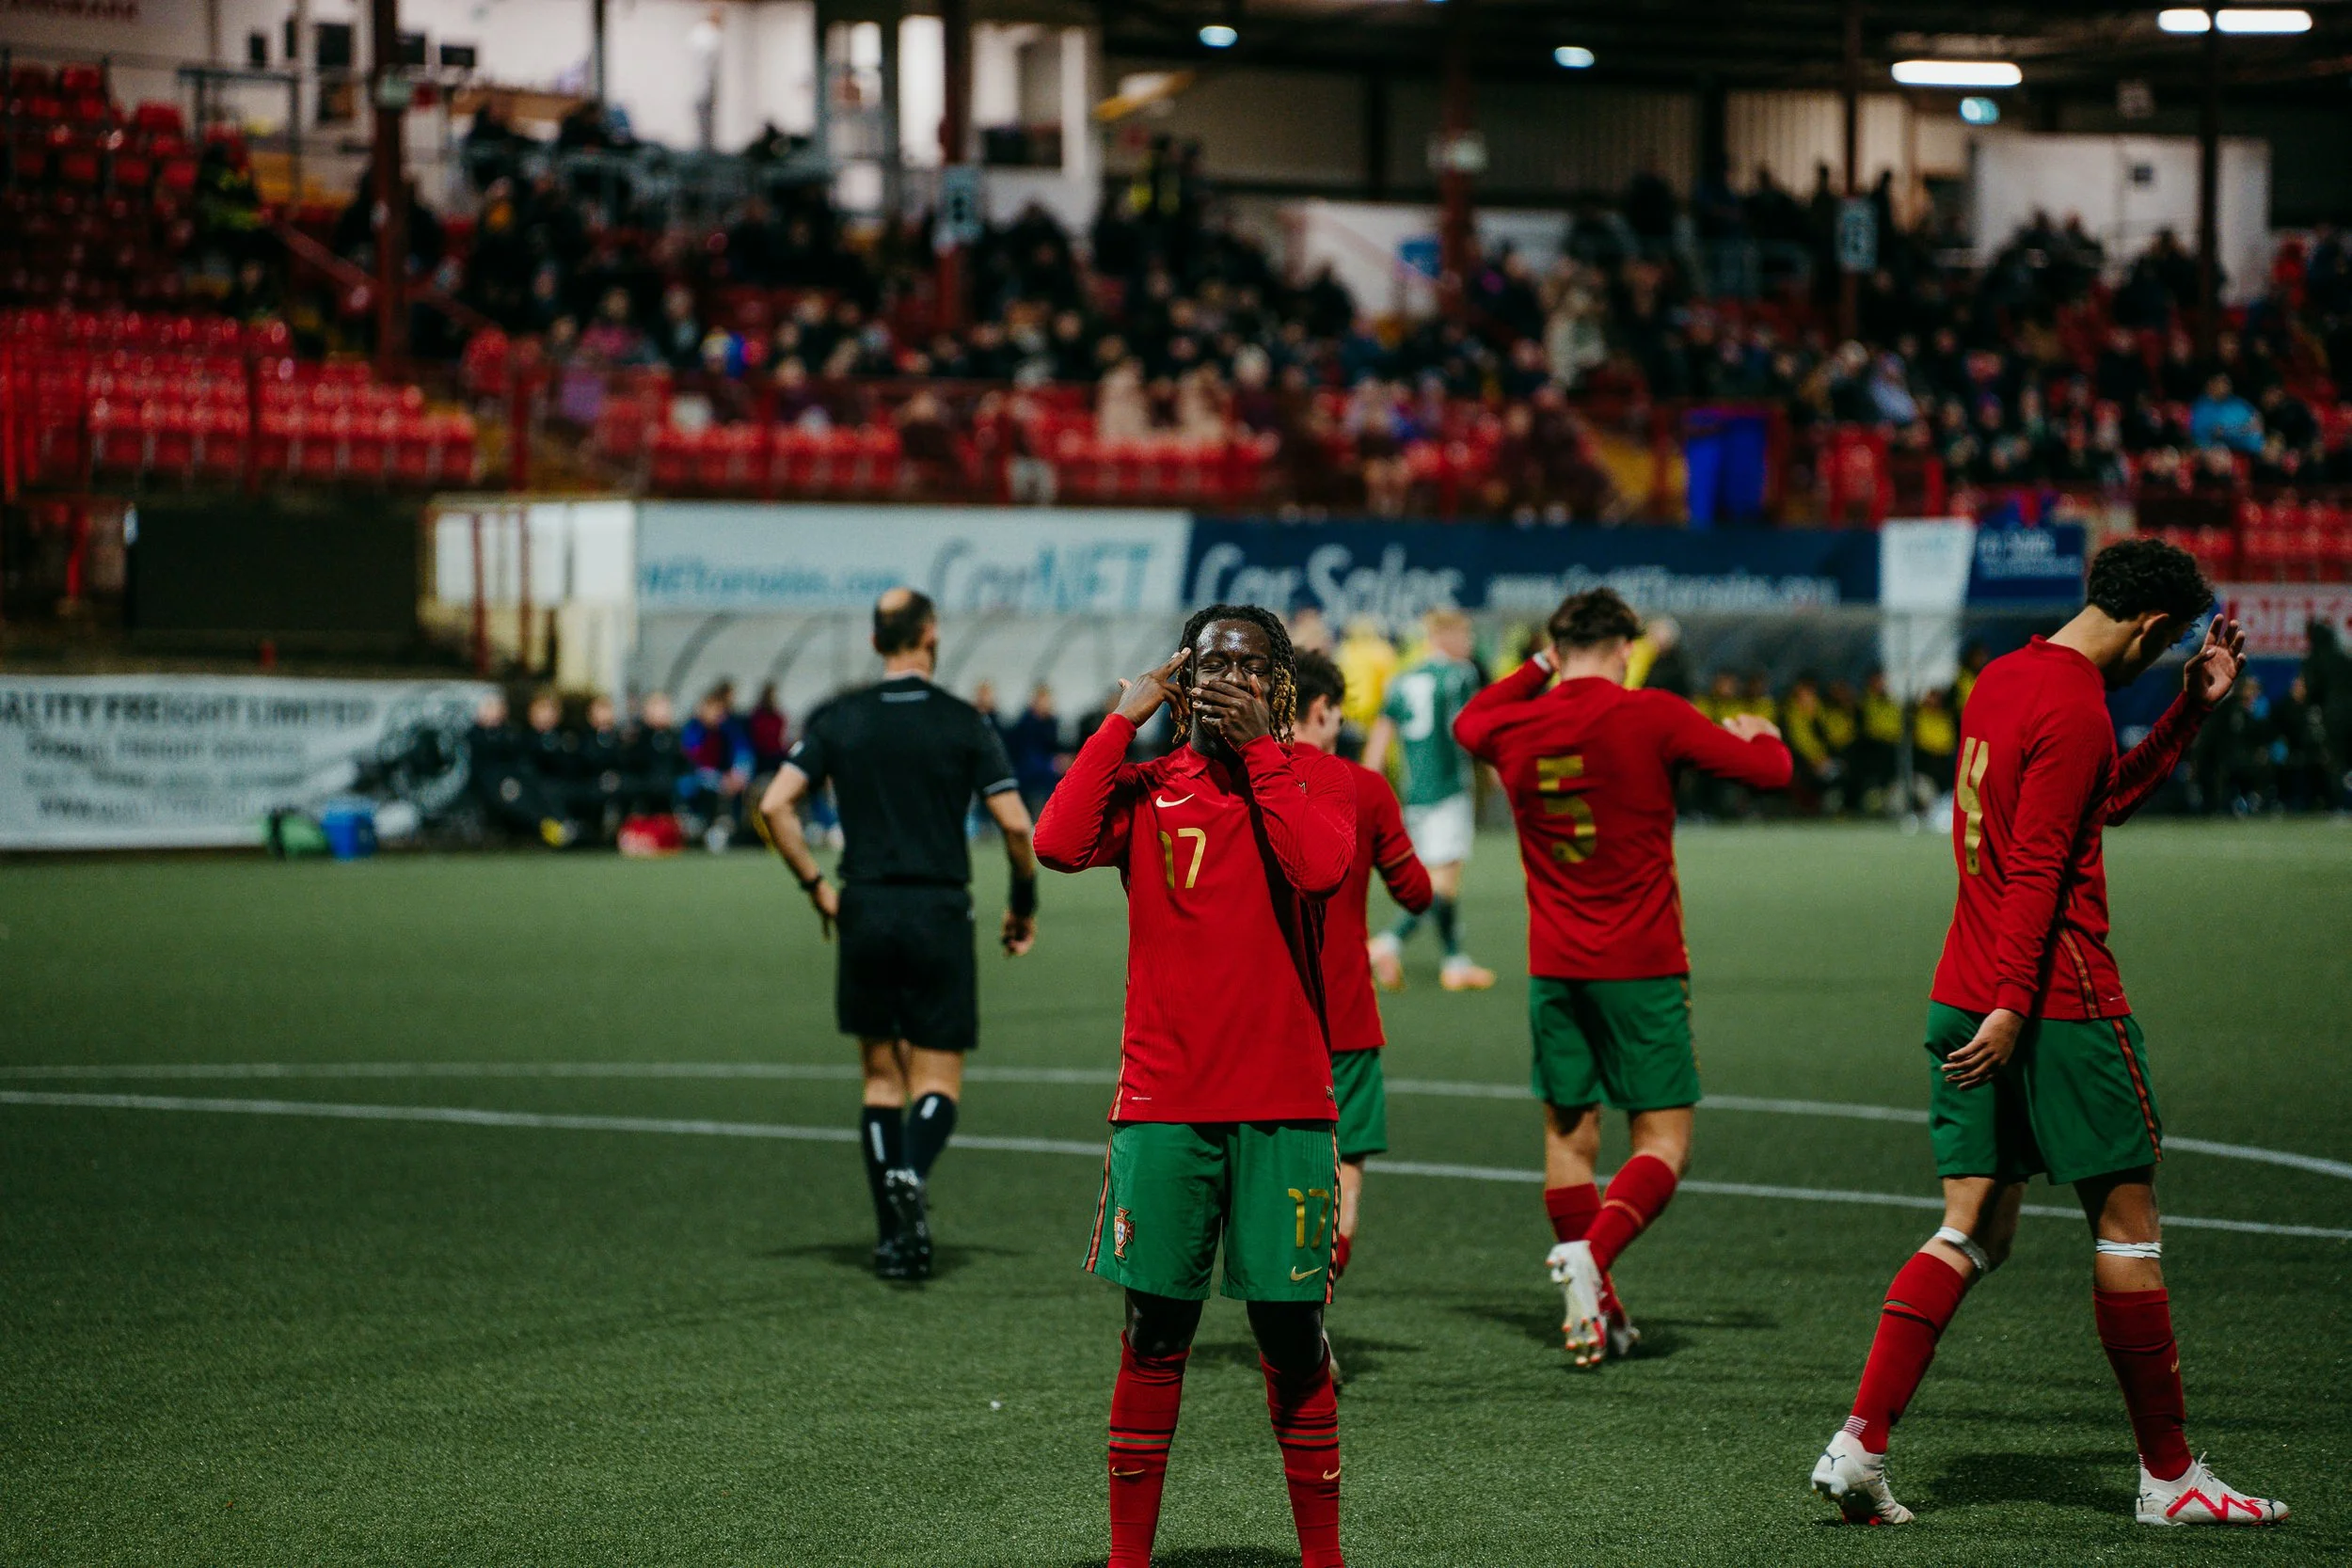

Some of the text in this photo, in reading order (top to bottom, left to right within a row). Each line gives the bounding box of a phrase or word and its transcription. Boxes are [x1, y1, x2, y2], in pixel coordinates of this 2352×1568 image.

[1536, 754, 1597, 864] 5
[1157, 827, 1207, 890] 17
[1287, 1188, 1331, 1250] 17
